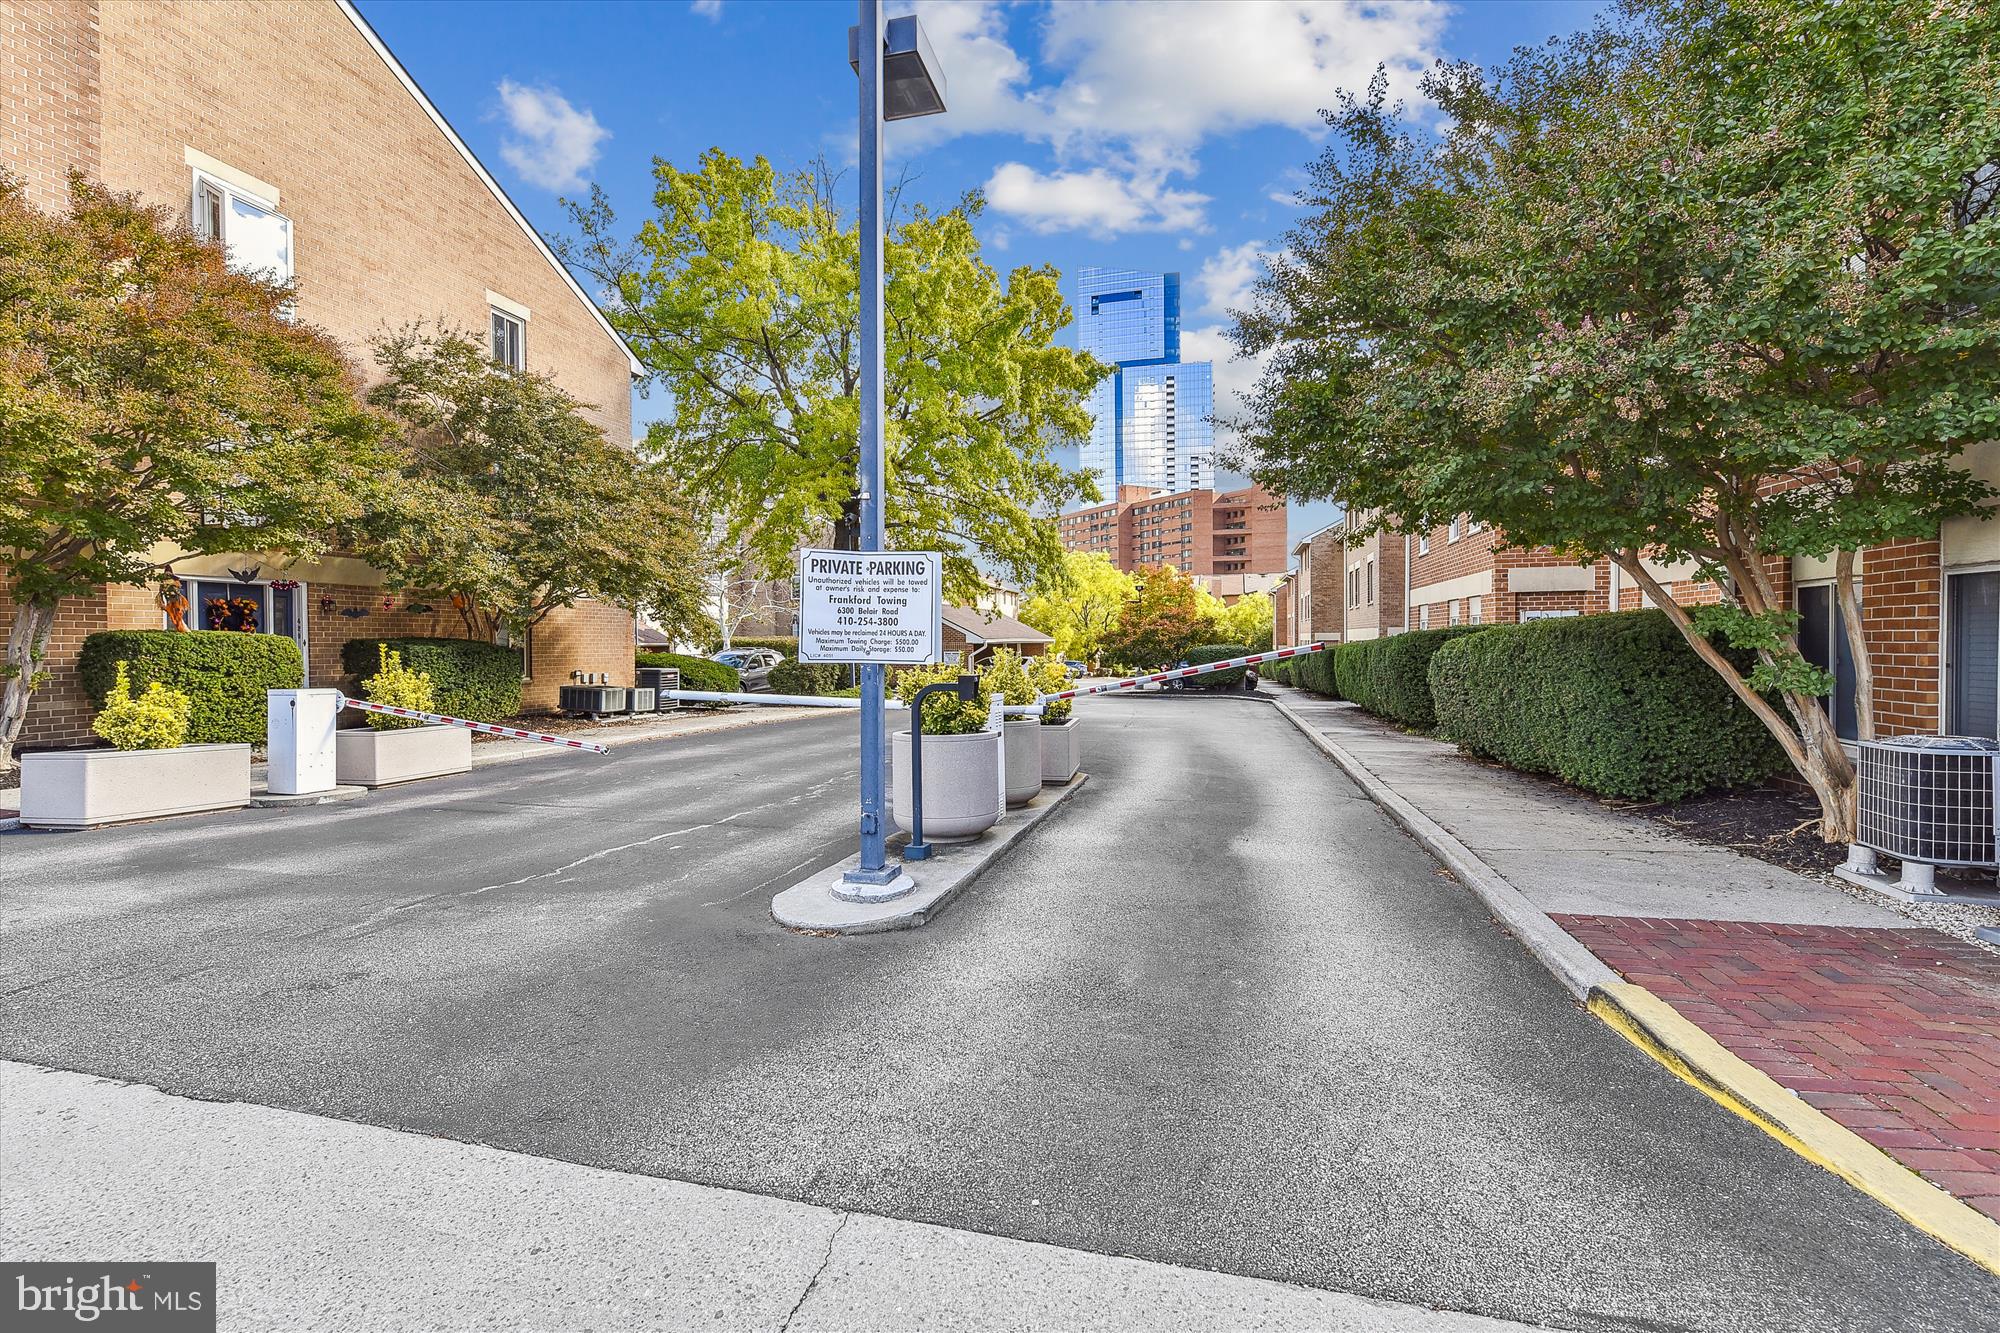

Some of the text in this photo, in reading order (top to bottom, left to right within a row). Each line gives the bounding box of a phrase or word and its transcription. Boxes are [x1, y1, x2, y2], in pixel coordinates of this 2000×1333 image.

[811, 559, 925, 575] PRIVATE PARKING
[808, 576, 852, 584] Unauthorized
[829, 595, 907, 606] Frankford Towing
[837, 617, 898, 626] 410-254-3800
[870, 638, 892, 646] Charge:
